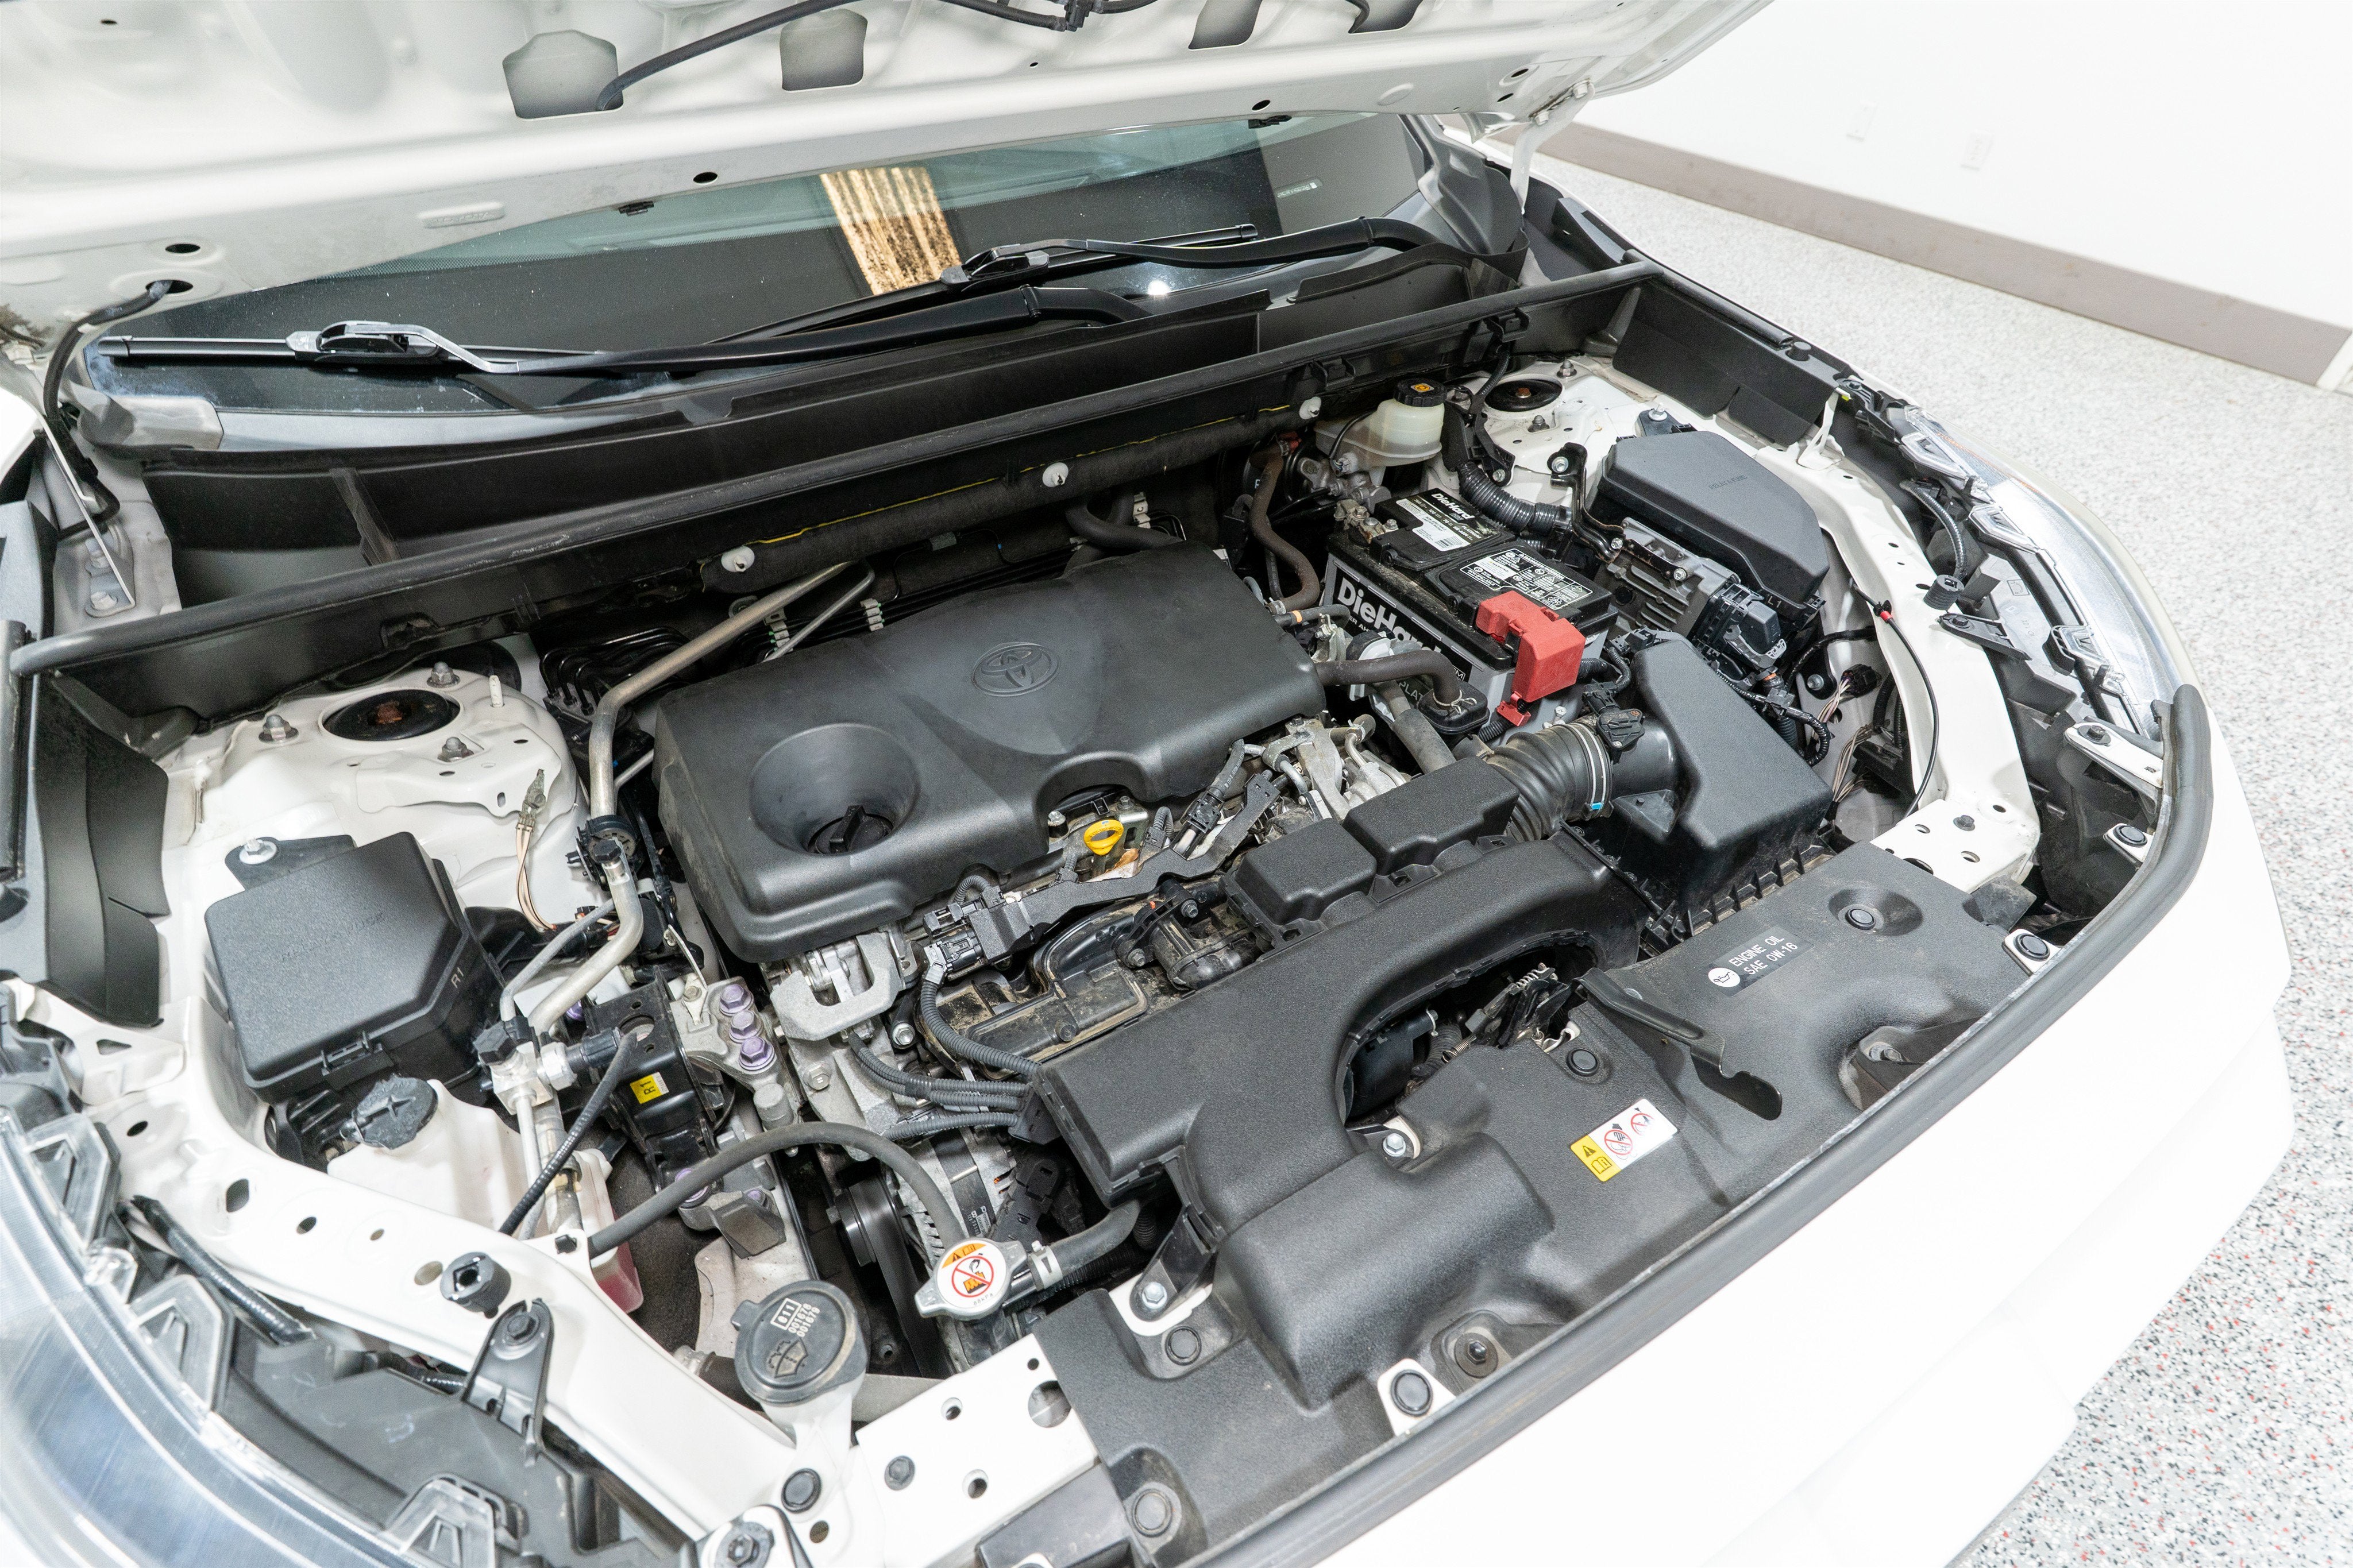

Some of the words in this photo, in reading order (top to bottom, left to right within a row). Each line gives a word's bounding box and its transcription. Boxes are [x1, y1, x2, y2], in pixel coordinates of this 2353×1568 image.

[1431, 493, 1475, 519] DieHard
[1767, 595, 1782, 608] L1
[1398, 681, 1424, 702] PLAT
[1728, 944, 1767, 967] ENGINE
[1764, 935, 1785, 946] OIL
[1743, 960, 1768, 975] SAE
[1765, 942, 1799, 961] 0W-16
[450, 966, 464, 988] R1
[639, 1080, 657, 1095] R1
[777, 1304, 796, 1324] 011
[788, 1303, 812, 1334] 001678
[796, 1307, 821, 1338] 001679
